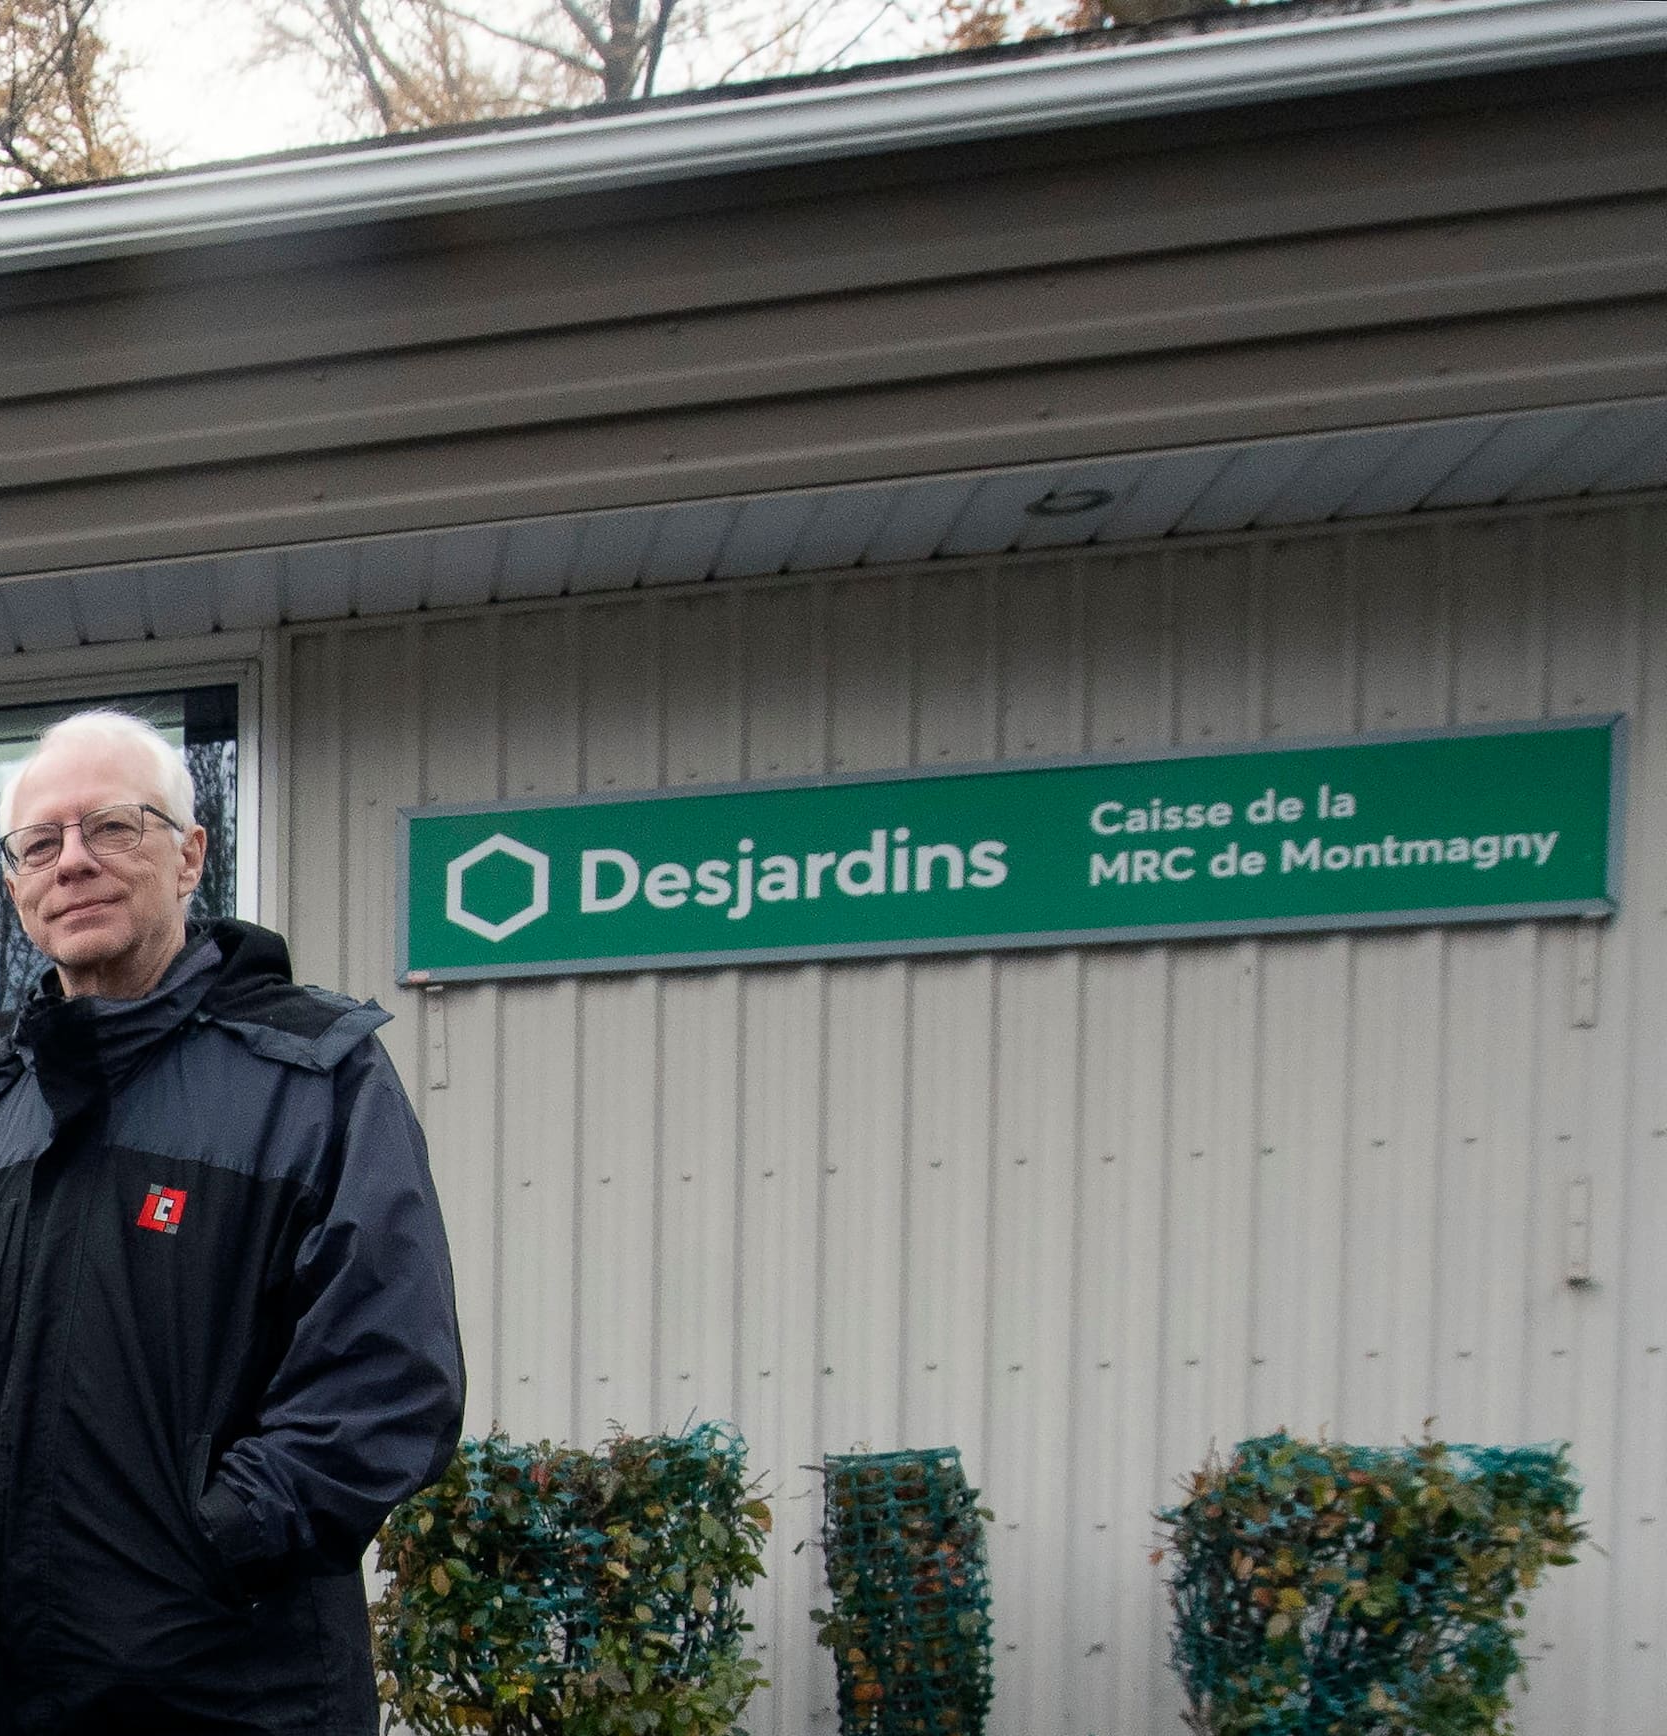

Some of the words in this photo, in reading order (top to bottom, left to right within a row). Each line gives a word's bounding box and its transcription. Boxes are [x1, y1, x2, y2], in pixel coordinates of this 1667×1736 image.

[1089, 799, 1234, 836] Caisse
[1245, 788, 1305, 825] de
[1317, 783, 1357, 820] la
[579, 826, 1009, 920] Desjardins
[1088, 846, 1197, 887] MRC
[1208, 841, 1267, 878] de
[1280, 830, 1561, 872] Montmagny
